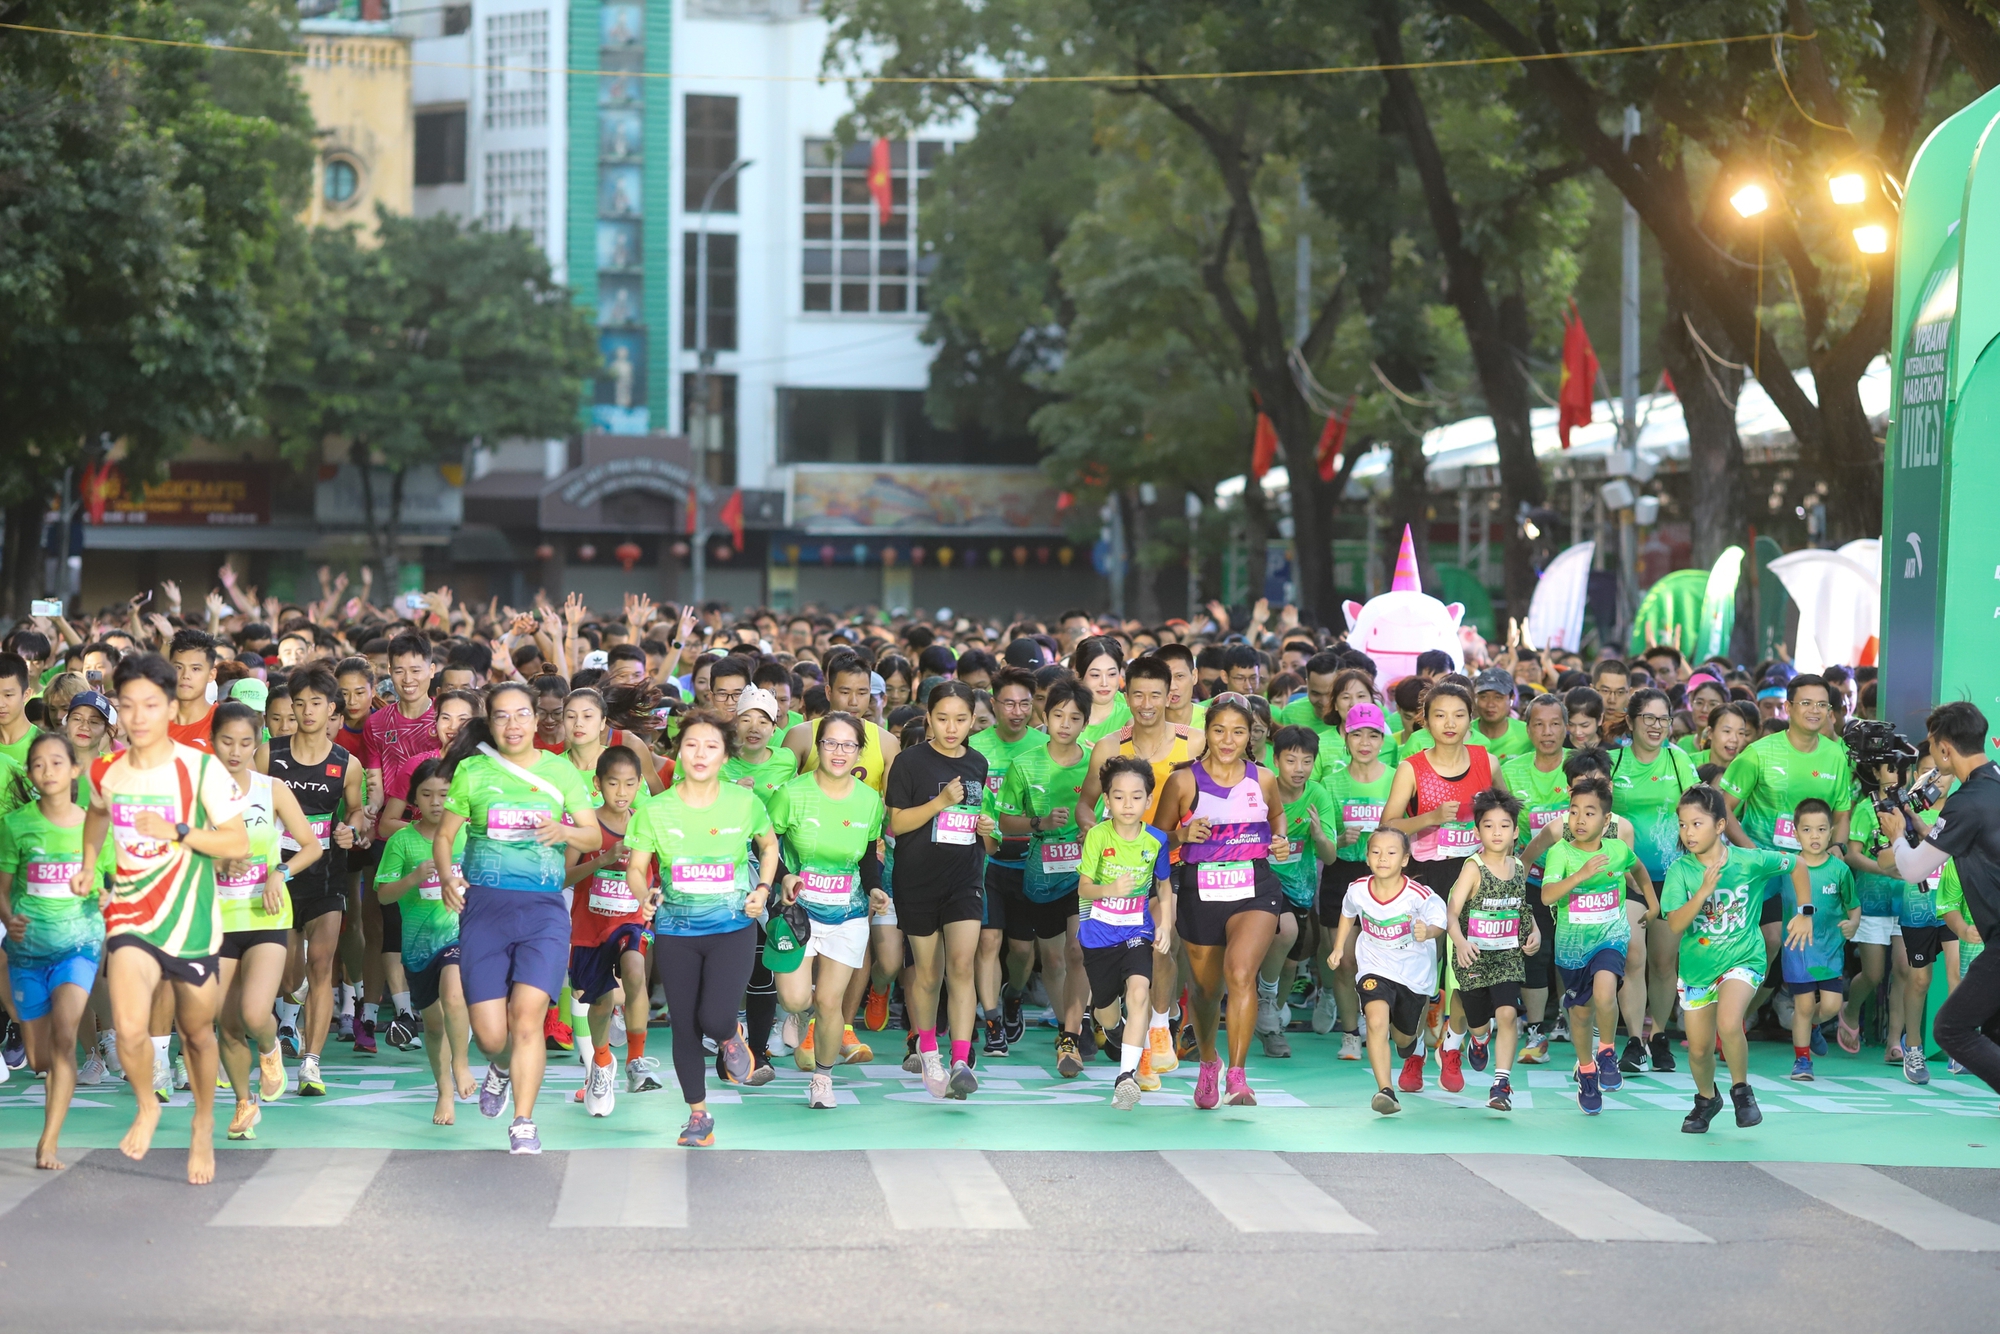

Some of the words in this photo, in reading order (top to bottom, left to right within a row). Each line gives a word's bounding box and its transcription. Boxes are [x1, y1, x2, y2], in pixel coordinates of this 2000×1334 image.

[1915, 321, 1950, 353] VPBANK
[1905, 353, 1944, 377] INTERNATIONAL
[1903, 374, 1943, 405] MARATHON
[1902, 405, 1941, 469] VIBES
[1904, 558, 1916, 578] ANTA
[284, 780, 330, 793] ANTA
[1537, 809, 1568, 825] 505
[1447, 831, 1475, 843] 5107
[1050, 844, 1082, 857] 5128
[682, 866, 725, 879] 50440
[1206, 870, 1246, 885] 51704
[807, 874, 845, 889] 50073
[1102, 897, 1137, 911] 55011
[1577, 892, 1613, 908] 50436
[1368, 921, 1402, 938] 50496
[1477, 920, 1513, 934] 50010
